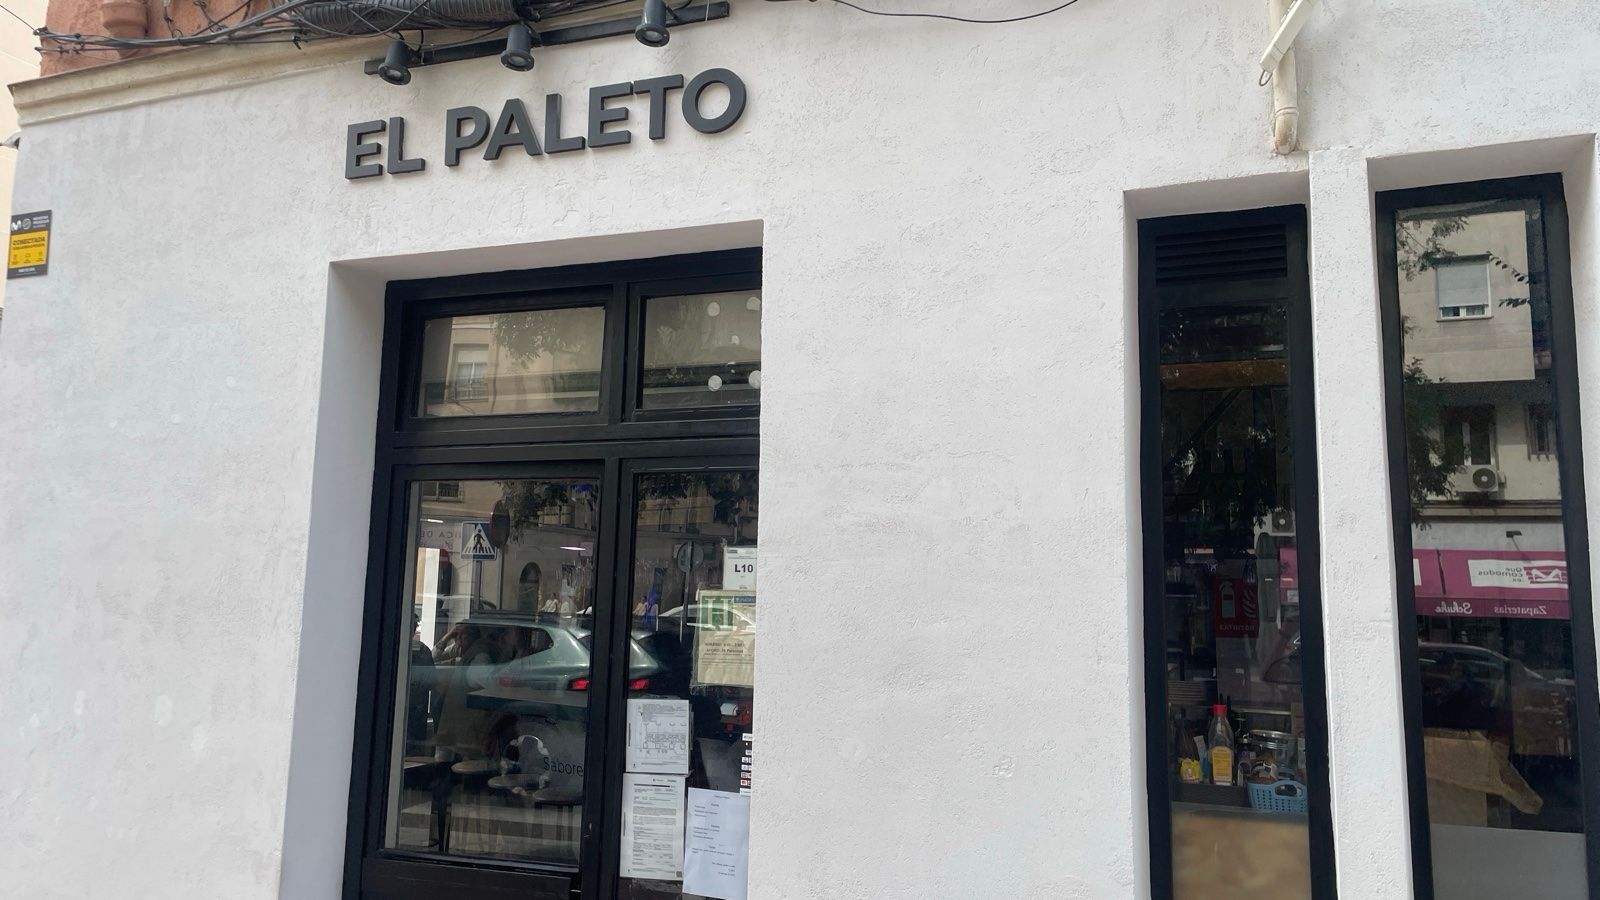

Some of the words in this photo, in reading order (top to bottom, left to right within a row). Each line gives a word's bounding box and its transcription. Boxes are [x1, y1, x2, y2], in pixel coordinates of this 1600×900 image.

[345, 116, 426, 181] EL
[444, 68, 748, 168] PALETO
[734, 563, 754, 573] L10
